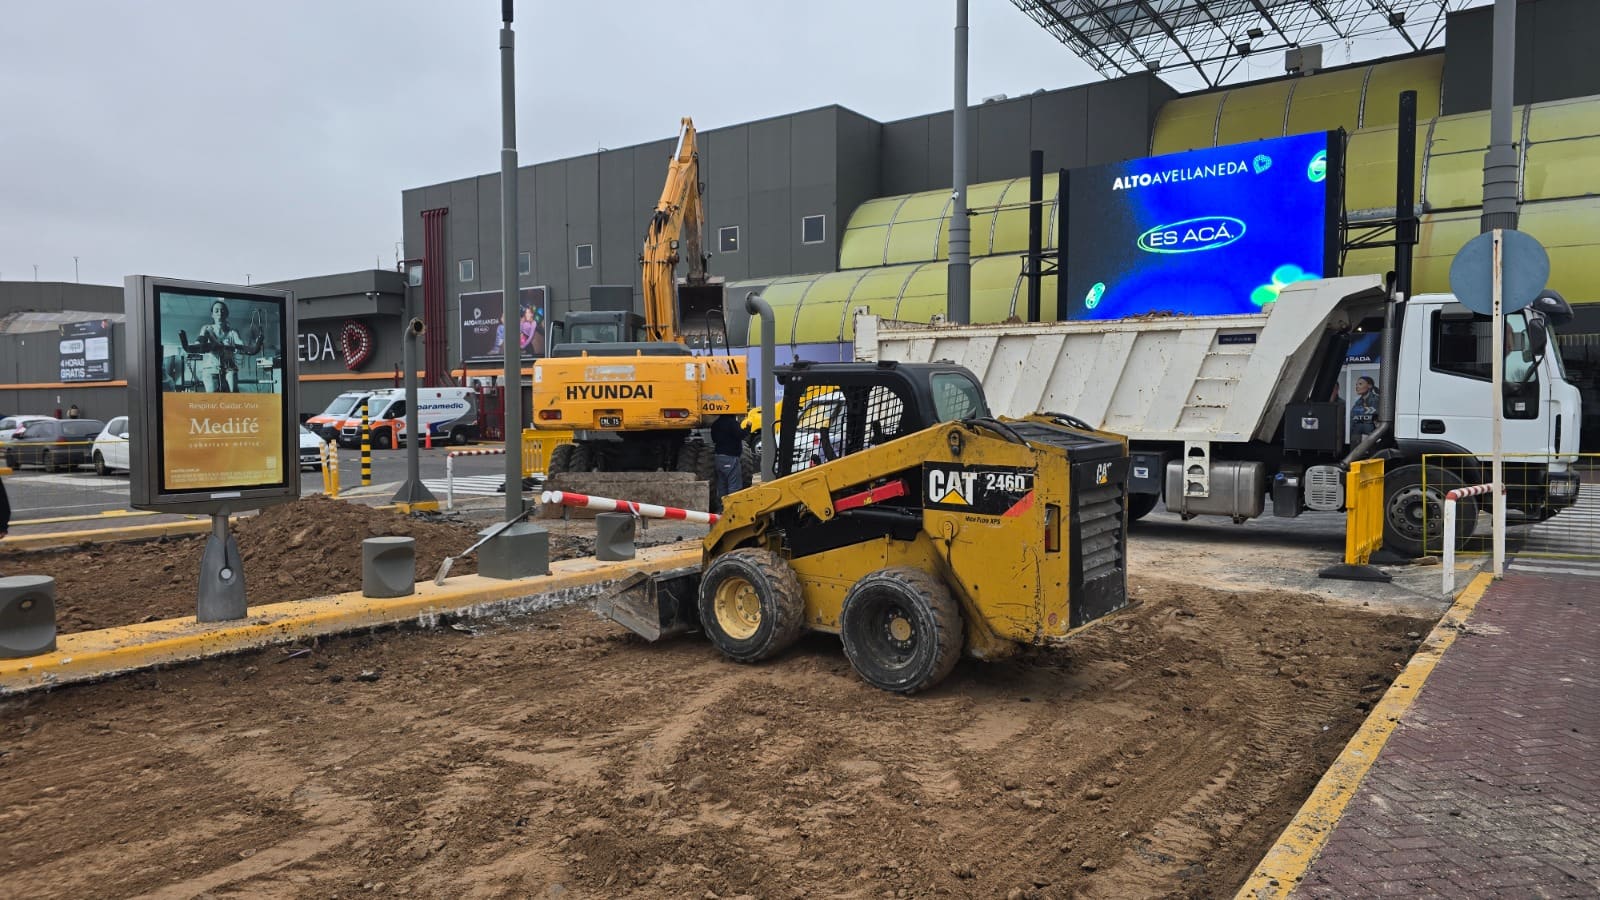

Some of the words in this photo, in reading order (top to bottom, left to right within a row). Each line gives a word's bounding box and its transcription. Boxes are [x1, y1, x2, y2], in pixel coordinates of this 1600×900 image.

[1150, 230, 1178, 247] ES
[1182, 222, 1235, 244] ACÁ.
[65, 358, 85, 367] HORAS
[60, 368, 86, 378] GRATIS
[566, 384, 653, 400] HYUNDAI
[188, 417, 259, 435] Medifé
[929, 469, 978, 506] CAT
[986, 473, 1026, 492] 246D
